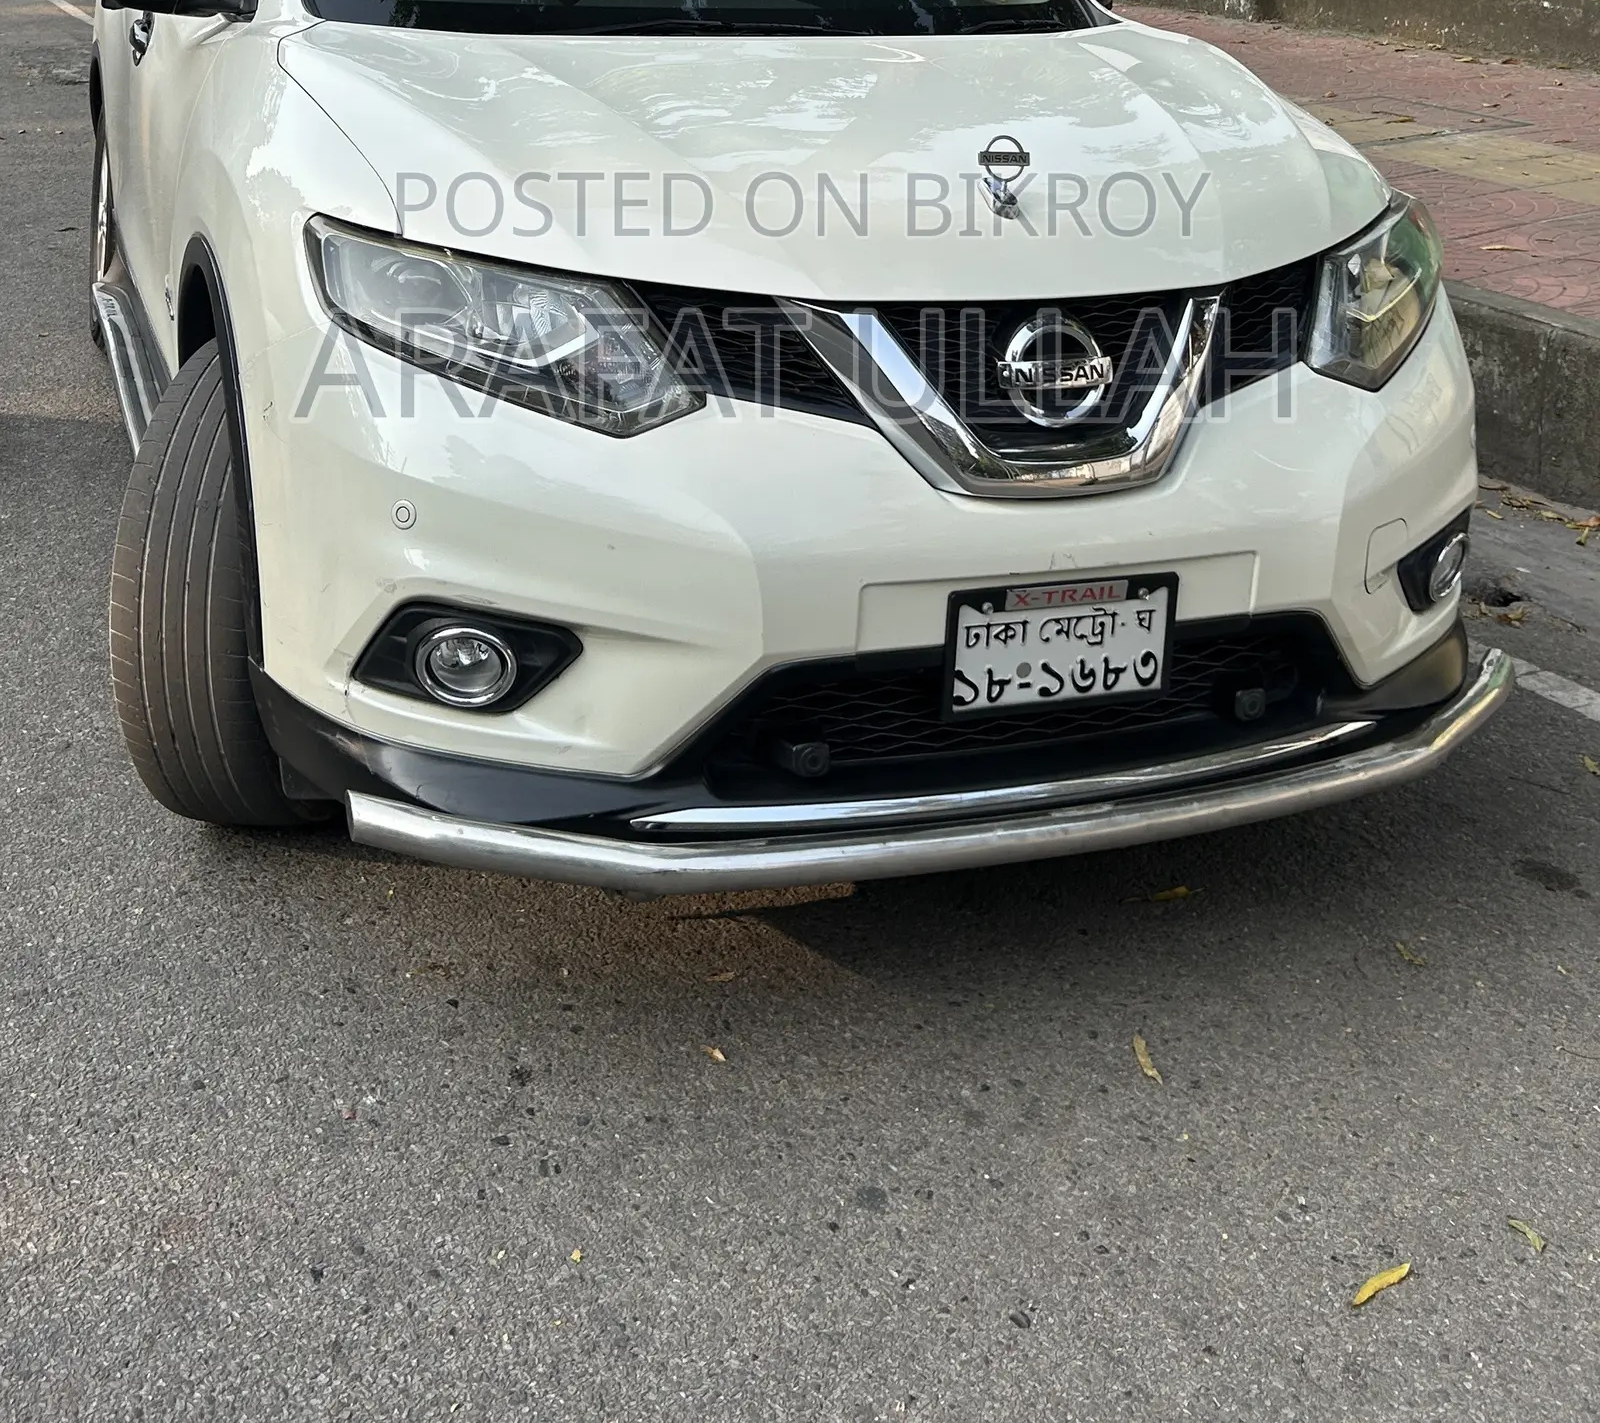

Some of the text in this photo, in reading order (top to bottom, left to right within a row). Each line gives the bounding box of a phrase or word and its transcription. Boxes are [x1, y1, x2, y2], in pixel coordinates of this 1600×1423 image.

[982, 154, 1029, 164] NISSAN
[1014, 362, 1105, 384] NISSAN
[1013, 584, 1122, 608] X-TRAIL
[964, 619, 1030, 648] ঢাকা
[953, 650, 1159, 707] ১৮-১৬৮৩
